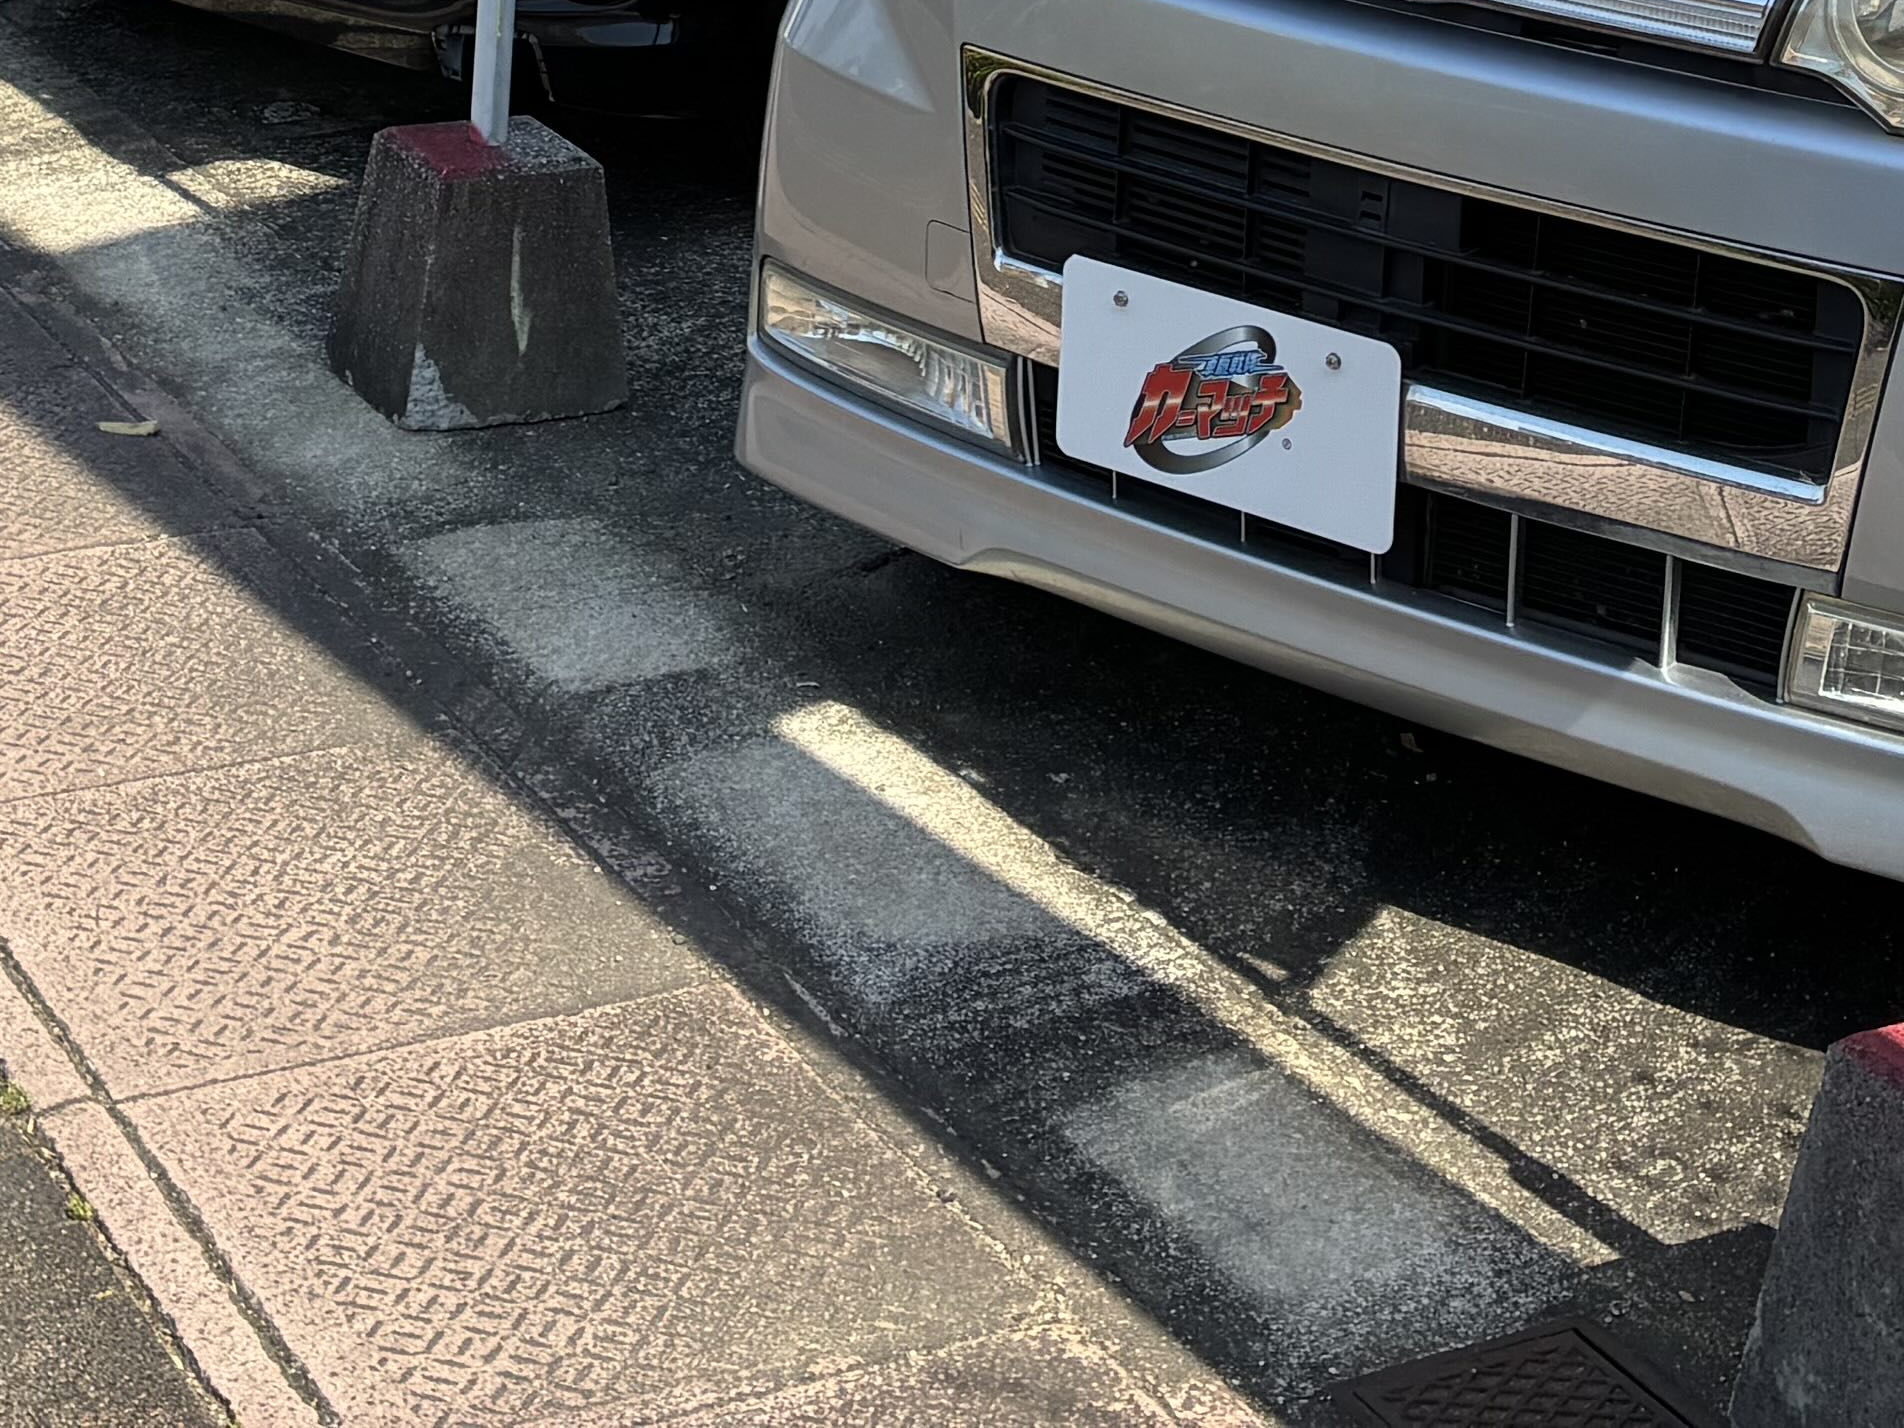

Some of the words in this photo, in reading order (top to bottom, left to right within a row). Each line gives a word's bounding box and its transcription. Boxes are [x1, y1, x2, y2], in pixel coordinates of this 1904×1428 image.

[1124, 363, 1289, 449] カーマッチ
